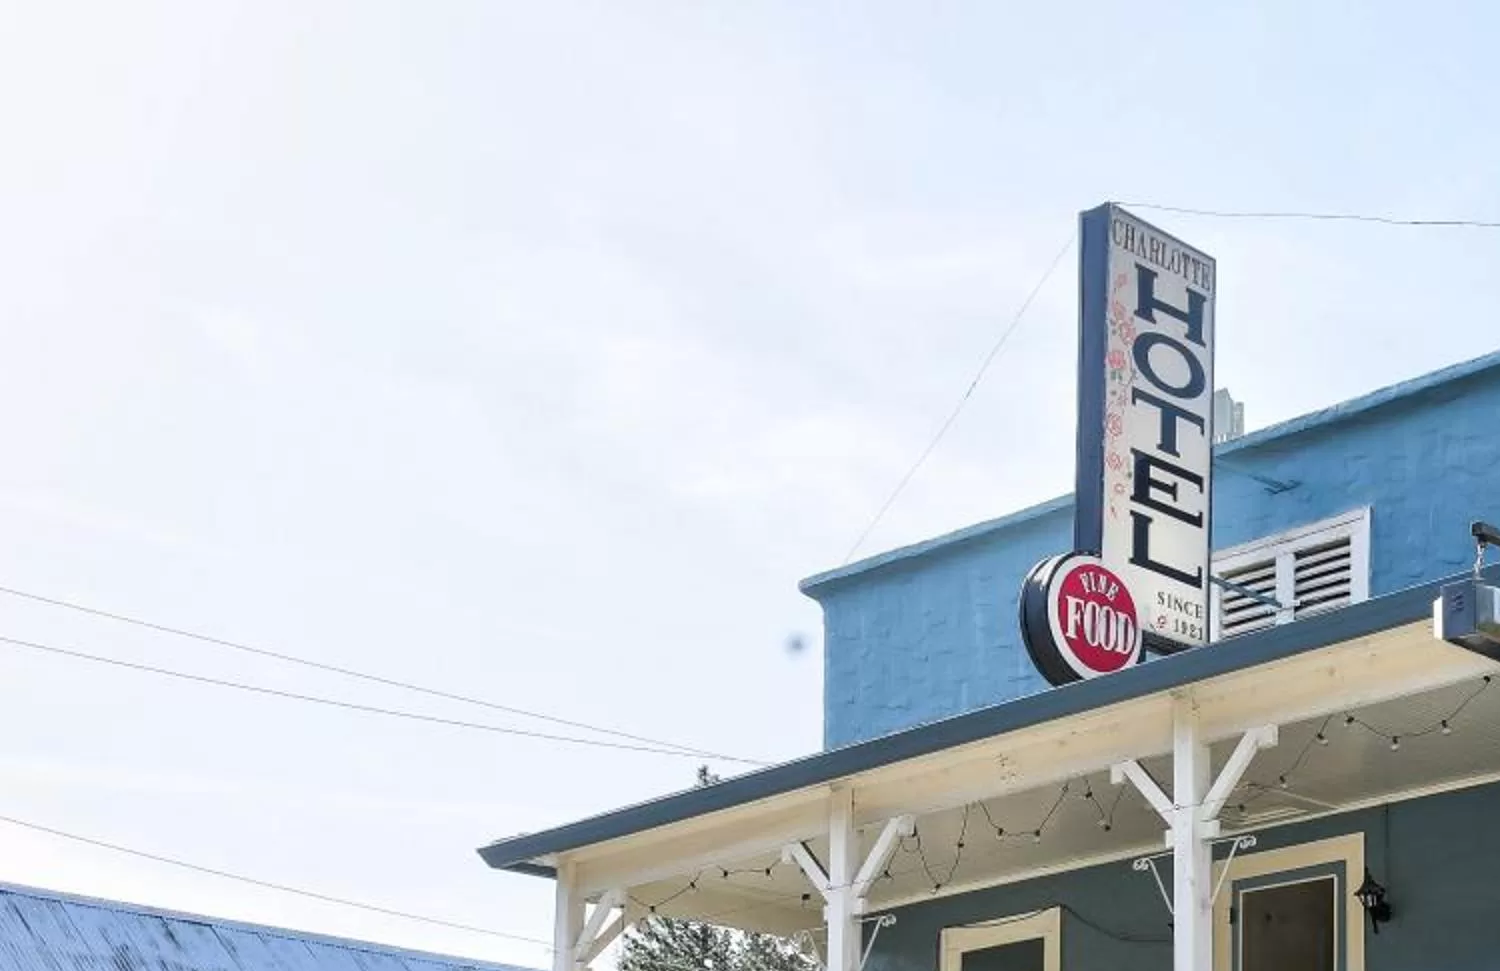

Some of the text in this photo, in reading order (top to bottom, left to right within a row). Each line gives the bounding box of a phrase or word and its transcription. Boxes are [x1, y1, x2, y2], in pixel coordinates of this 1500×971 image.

[1113, 218, 1210, 291] CHARLOTTE
[1129, 262, 1207, 589] HOTEL
[1065, 595, 1135, 655] FOOD
[1157, 591, 1203, 619] SINCE
